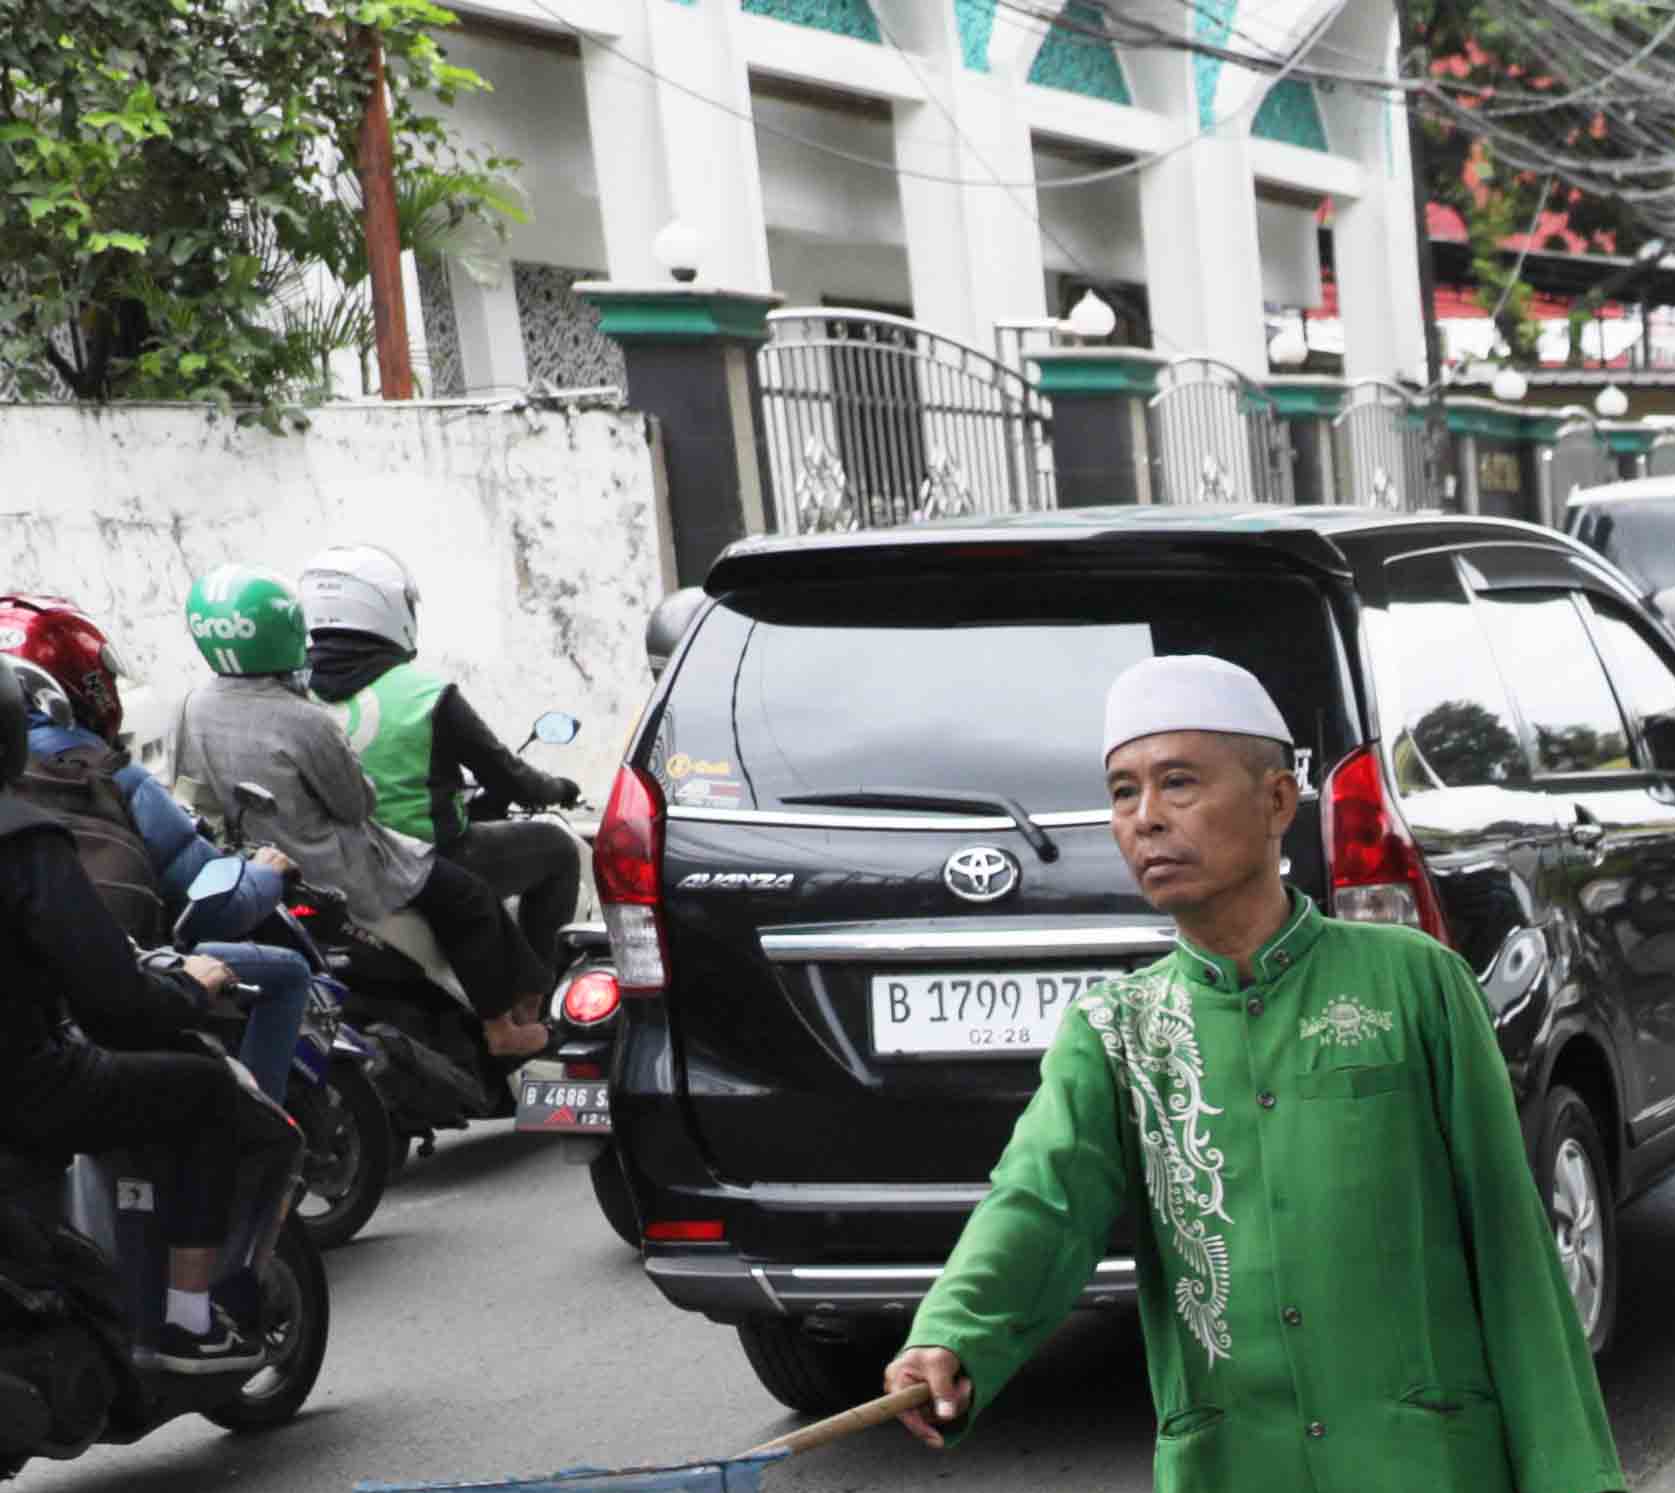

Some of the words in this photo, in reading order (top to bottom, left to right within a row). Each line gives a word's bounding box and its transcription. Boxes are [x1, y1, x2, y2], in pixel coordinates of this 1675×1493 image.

[190, 612, 256, 640] Grab
[676, 873, 794, 889] AVANZA
[888, 982, 911, 1023] B
[927, 980, 1022, 1023] 1799
[526, 1086, 537, 1105] B
